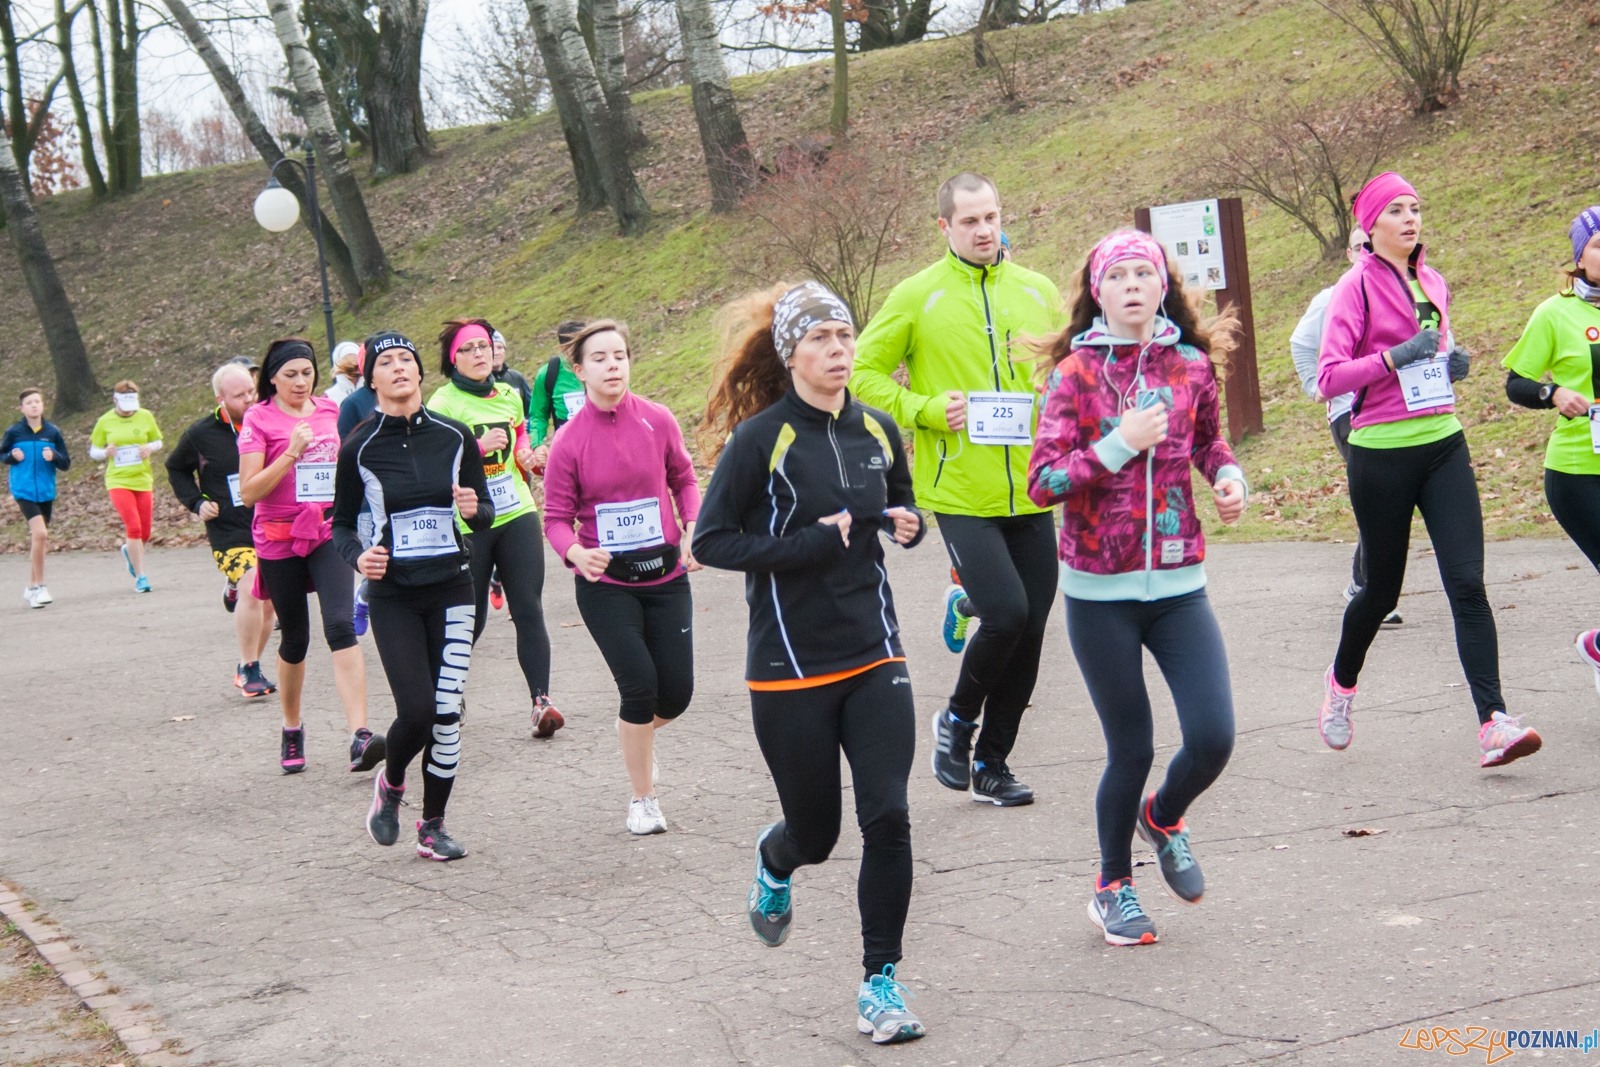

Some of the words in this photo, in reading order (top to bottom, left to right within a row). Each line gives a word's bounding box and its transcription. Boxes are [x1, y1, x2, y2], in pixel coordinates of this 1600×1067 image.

[374, 338, 415, 353] HELLO
[1423, 367, 1442, 380] 645
[992, 407, 1013, 418] 225
[314, 472, 330, 480] 434
[491, 486, 507, 496] 191
[412, 519, 438, 530] 1082
[616, 513, 644, 527] 1079
